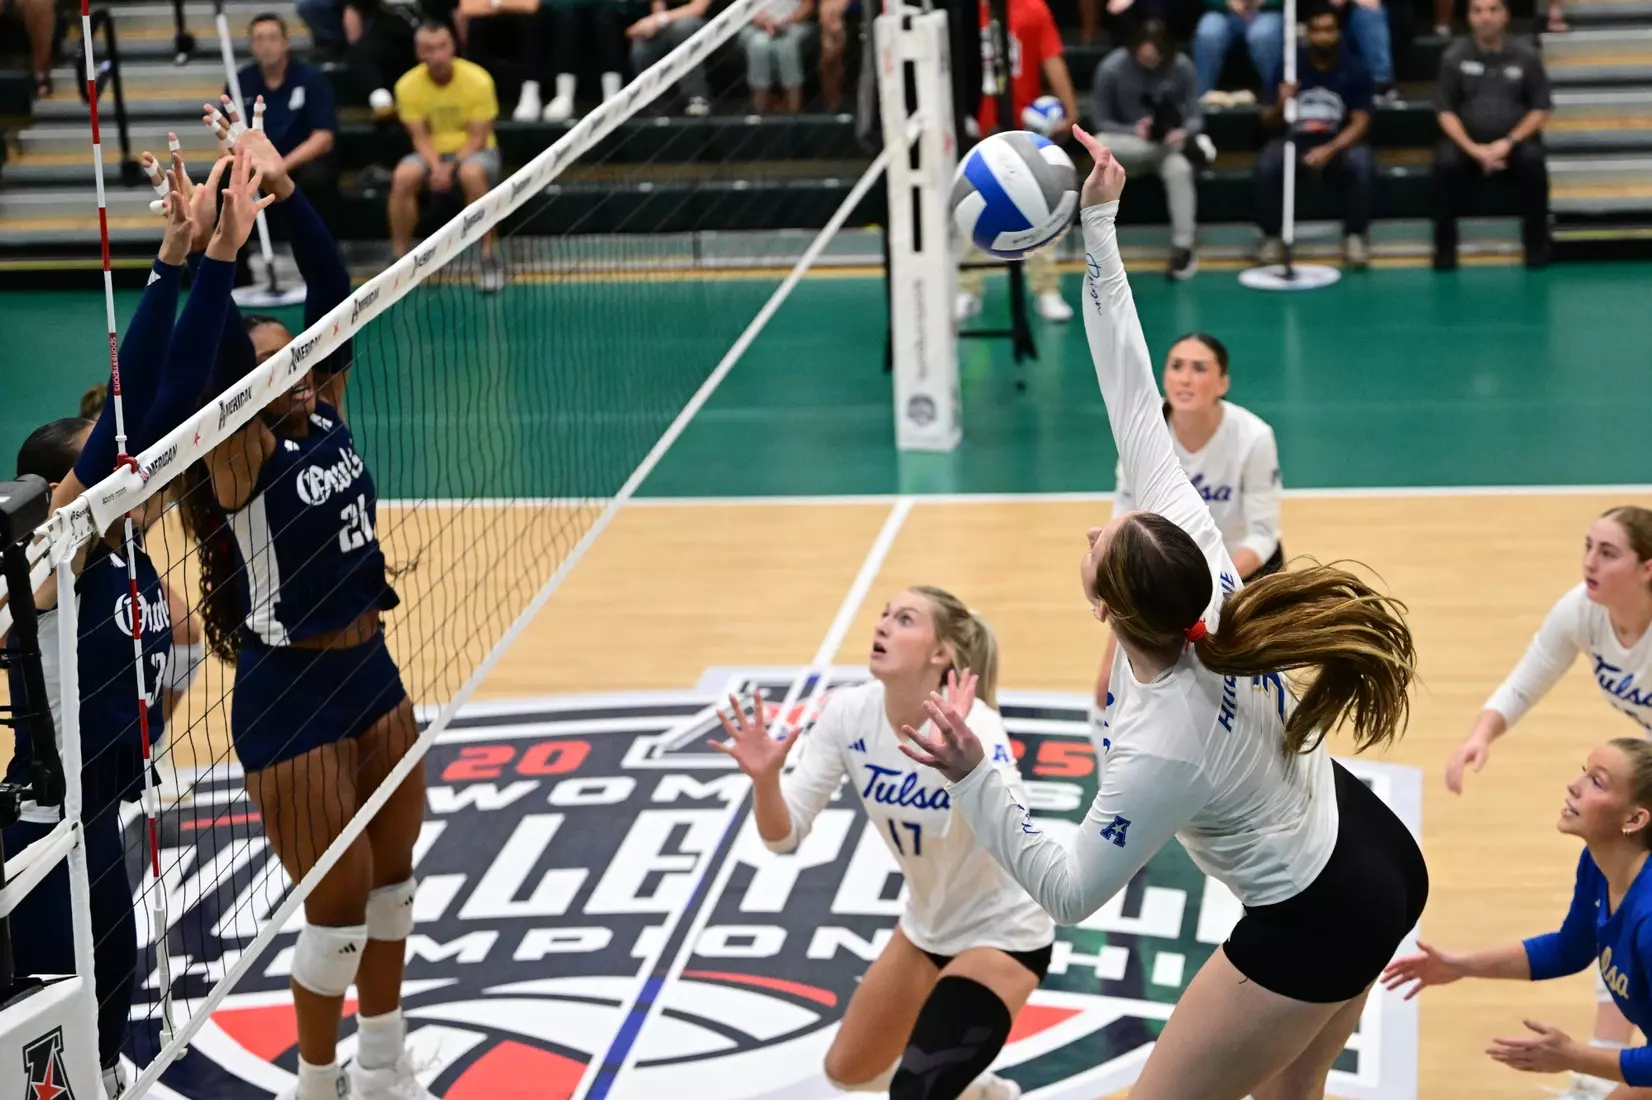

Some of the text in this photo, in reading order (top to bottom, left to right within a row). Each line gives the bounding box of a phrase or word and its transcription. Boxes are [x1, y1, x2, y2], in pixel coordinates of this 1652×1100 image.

[1190, 472, 1231, 501] lsa
[339, 493, 374, 553] 21
[114, 588, 170, 636] Owl
[441, 739, 1096, 782] 20 5
[863, 764, 951, 810] Tulsa
[888, 817, 921, 856] 17
[1601, 946, 1629, 999] lsa
